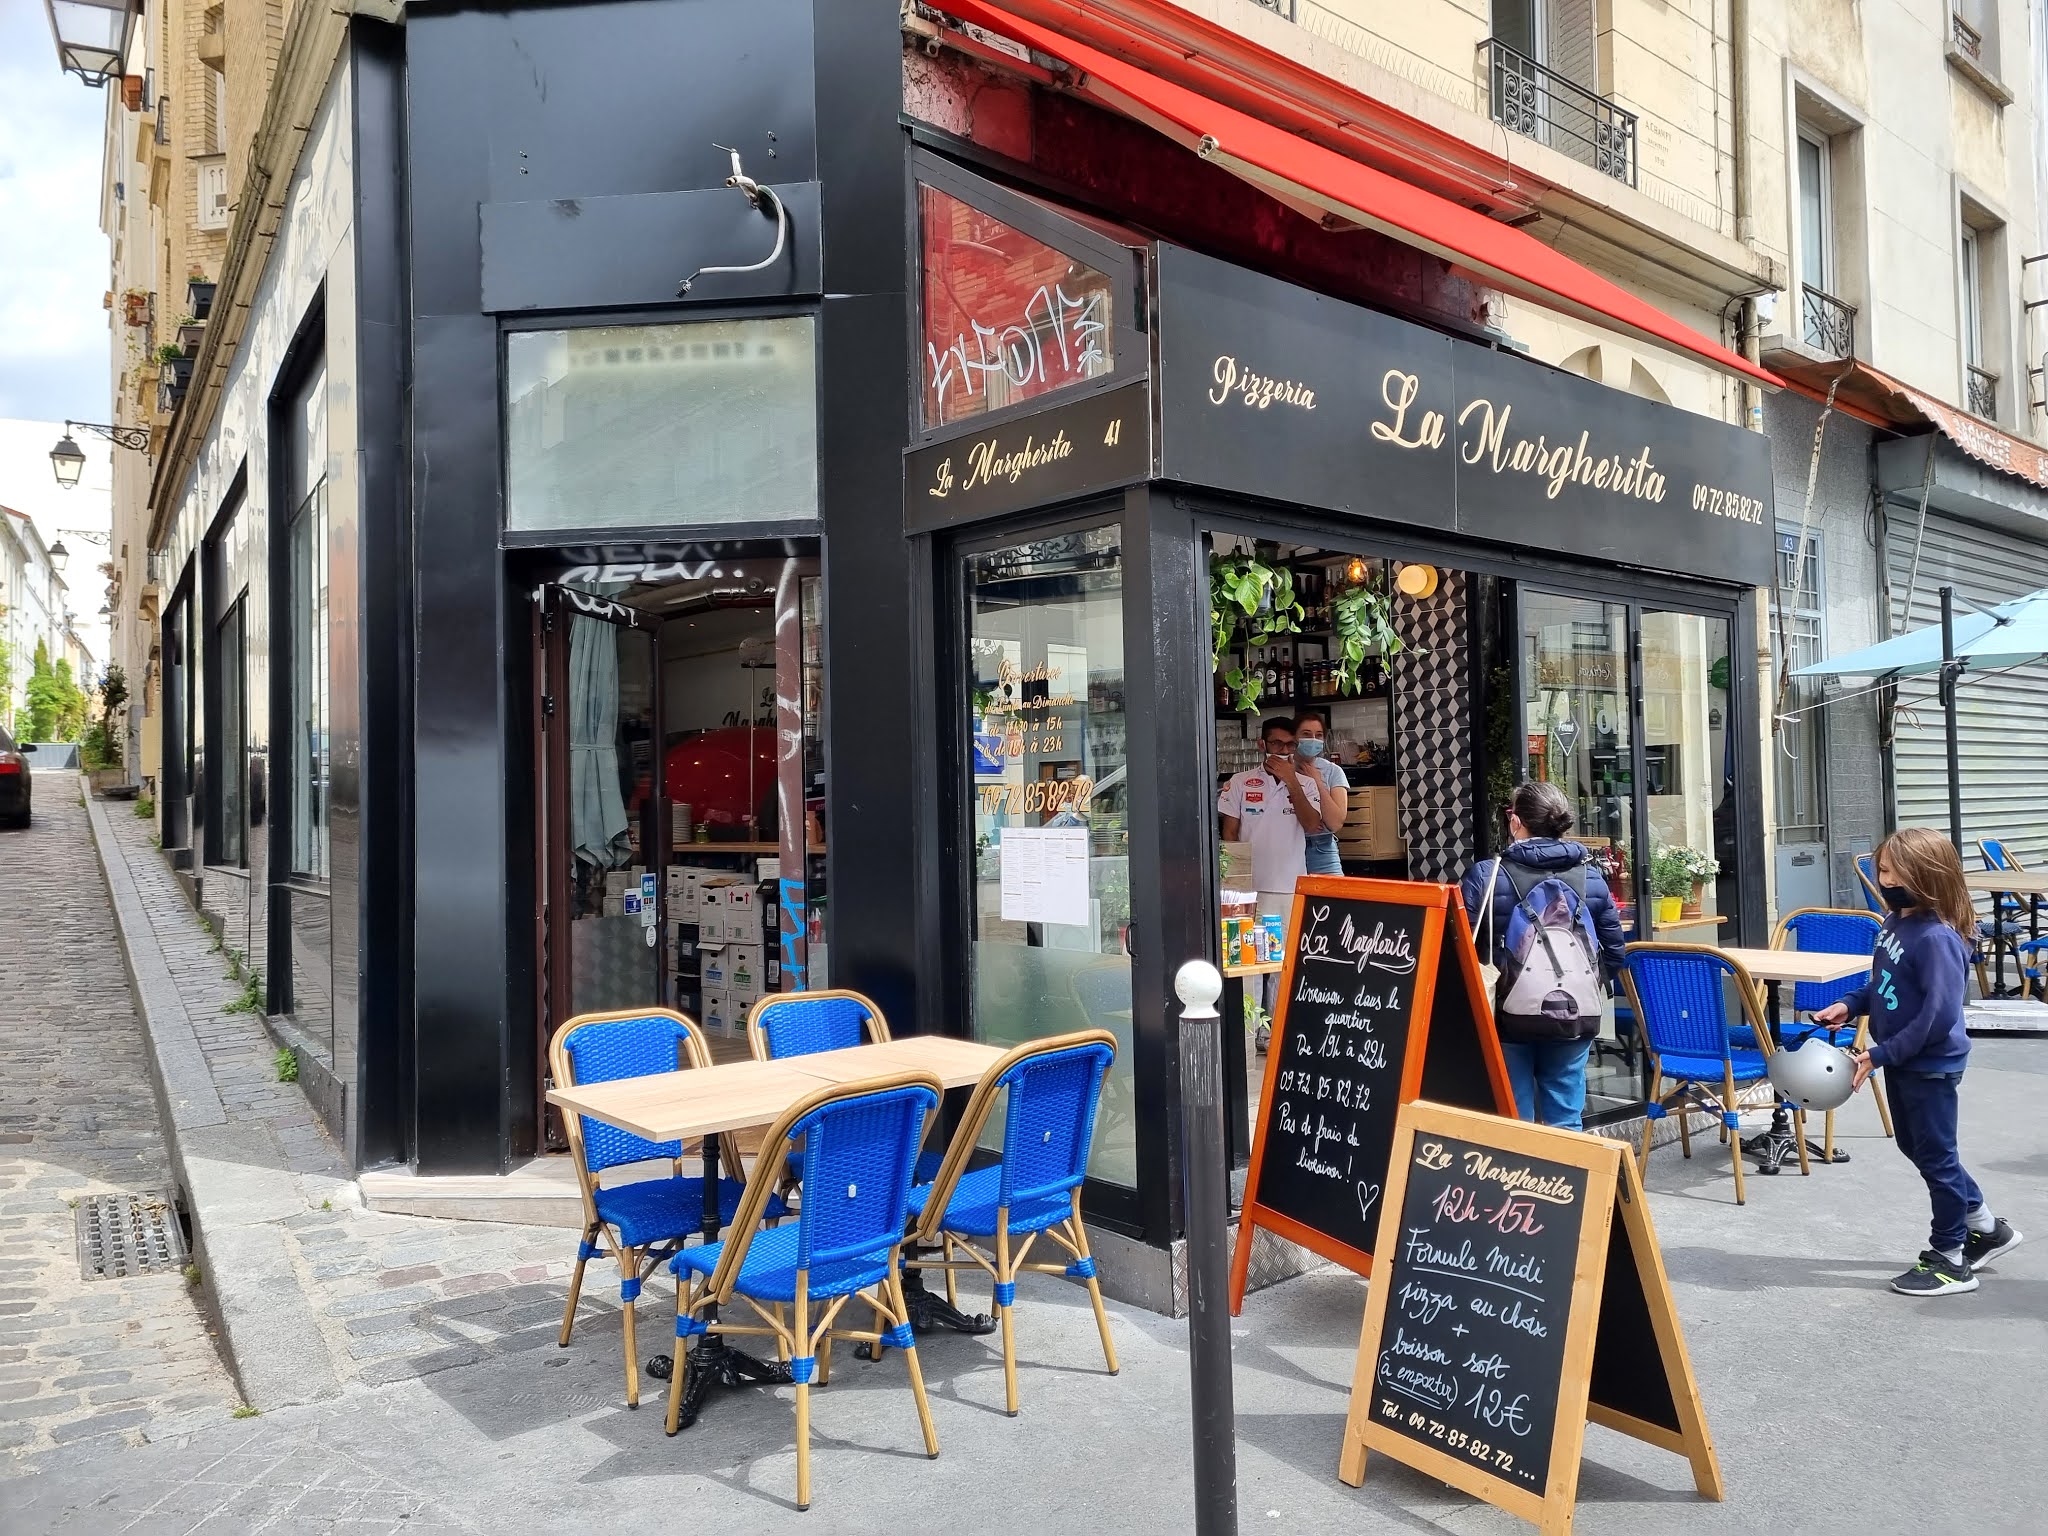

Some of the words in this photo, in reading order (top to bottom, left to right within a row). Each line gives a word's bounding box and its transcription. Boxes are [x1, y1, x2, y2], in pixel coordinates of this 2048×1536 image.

[1209, 355, 1317, 409] Pizzeria
[1104, 419, 1121, 447] 41
[1371, 369, 1446, 449] La
[1458, 399, 1666, 503] Margherita
[929, 457, 954, 497] La
[963, 430, 1074, 490] Margherita
[1784, 536, 1794, 550] 43
[1022, 701, 1032, 709] au
[1046, 716, 1062, 731] 15h
[1042, 736, 1063, 753] 23h
[1300, 905, 1330, 955] La
[1339, 913, 1414, 973] Margherita
[1295, 976, 1344, 1006] livraison
[1354, 985, 1381, 1010] dans
[1386, 986, 1401, 1010] le
[1325, 1011, 1374, 1037] quartier
[1297, 1034, 1313, 1056] De
[1318, 1034, 1341, 1058] 19h
[1346, 1040, 1355, 1057] à
[1279, 1101, 1296, 1134] Pas
[1301, 1114, 1311, 1136] de
[1316, 1115, 1342, 1154] frais
[1347, 1122, 1360, 1146] de
[1415, 1143, 1453, 1170] La
[1464, 1151, 1574, 1199] Margherita
[1406, 1227, 1478, 1271] Formule
[1486, 1245, 1546, 1284] Midi
[1399, 1281, 1458, 1325] pizza
[1470, 1298, 1497, 1317] au
[1462, 1352, 1511, 1380] soft
[1465, 1384, 1532, 1436] 12€
